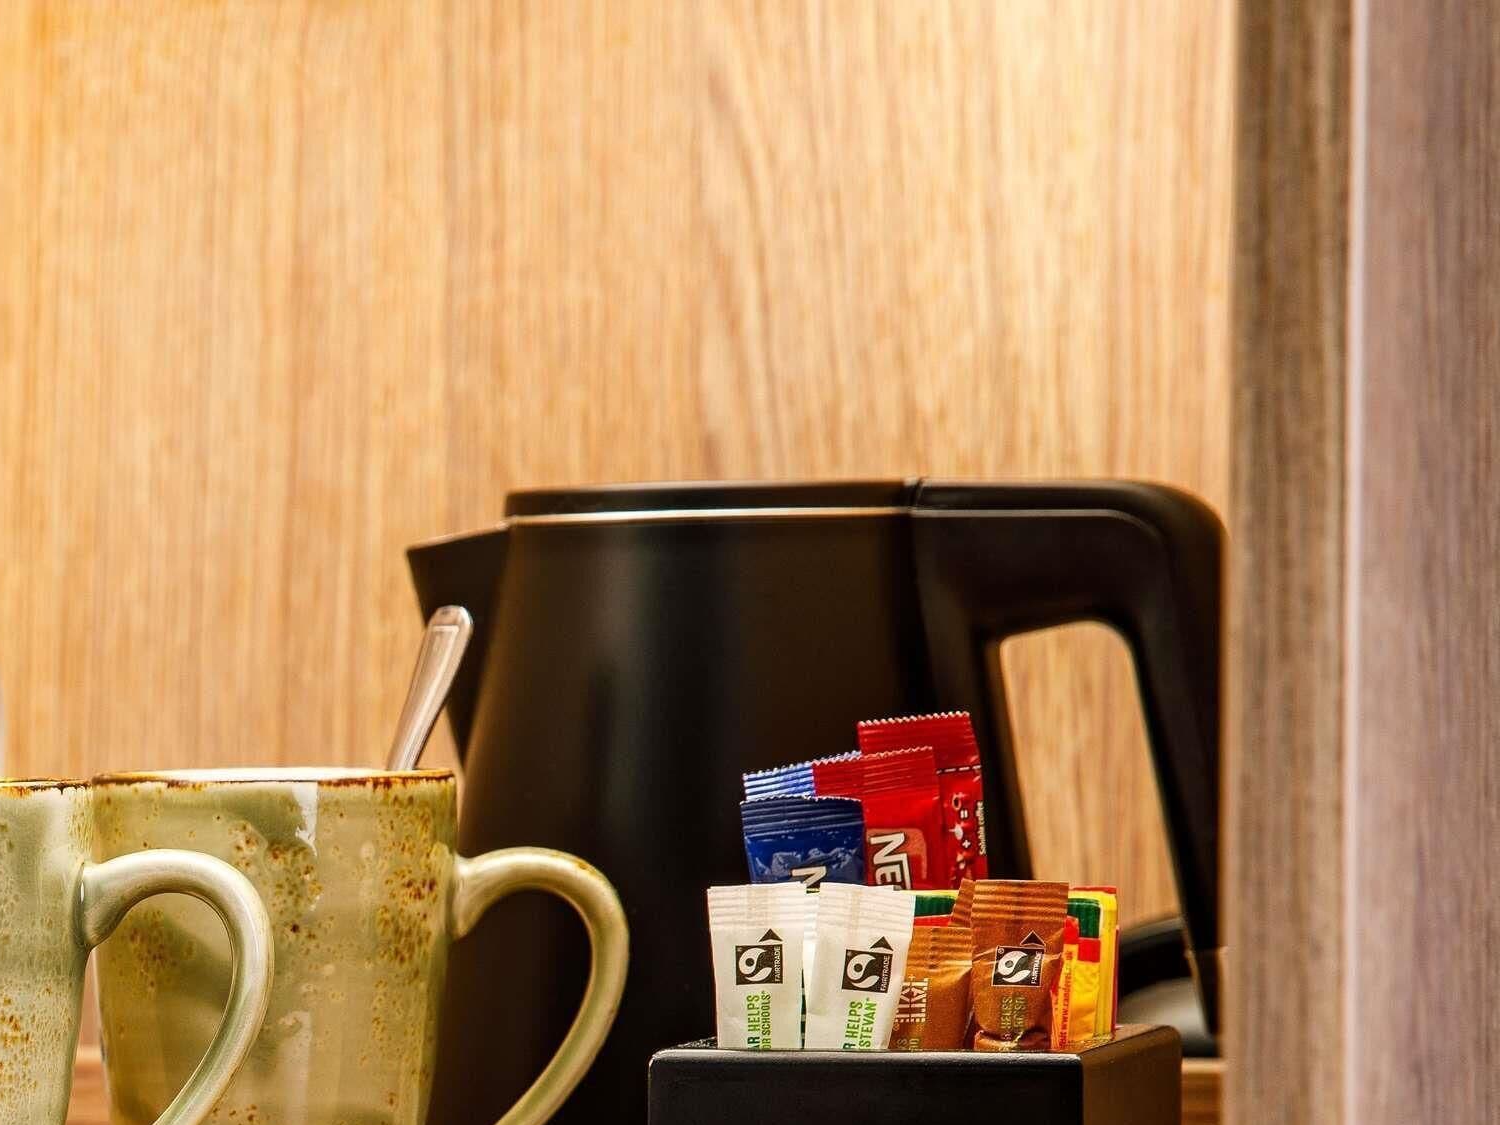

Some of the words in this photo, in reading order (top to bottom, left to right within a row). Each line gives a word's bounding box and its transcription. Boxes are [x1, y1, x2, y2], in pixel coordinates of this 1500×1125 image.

[774, 945, 782, 983] FAIRTRADE
[880, 955, 891, 992] FAIRTRADE
[1030, 950, 1044, 985] FAIRTRADE
[746, 994, 760, 1033] HELPS
[846, 1001, 863, 1039] HELPS
